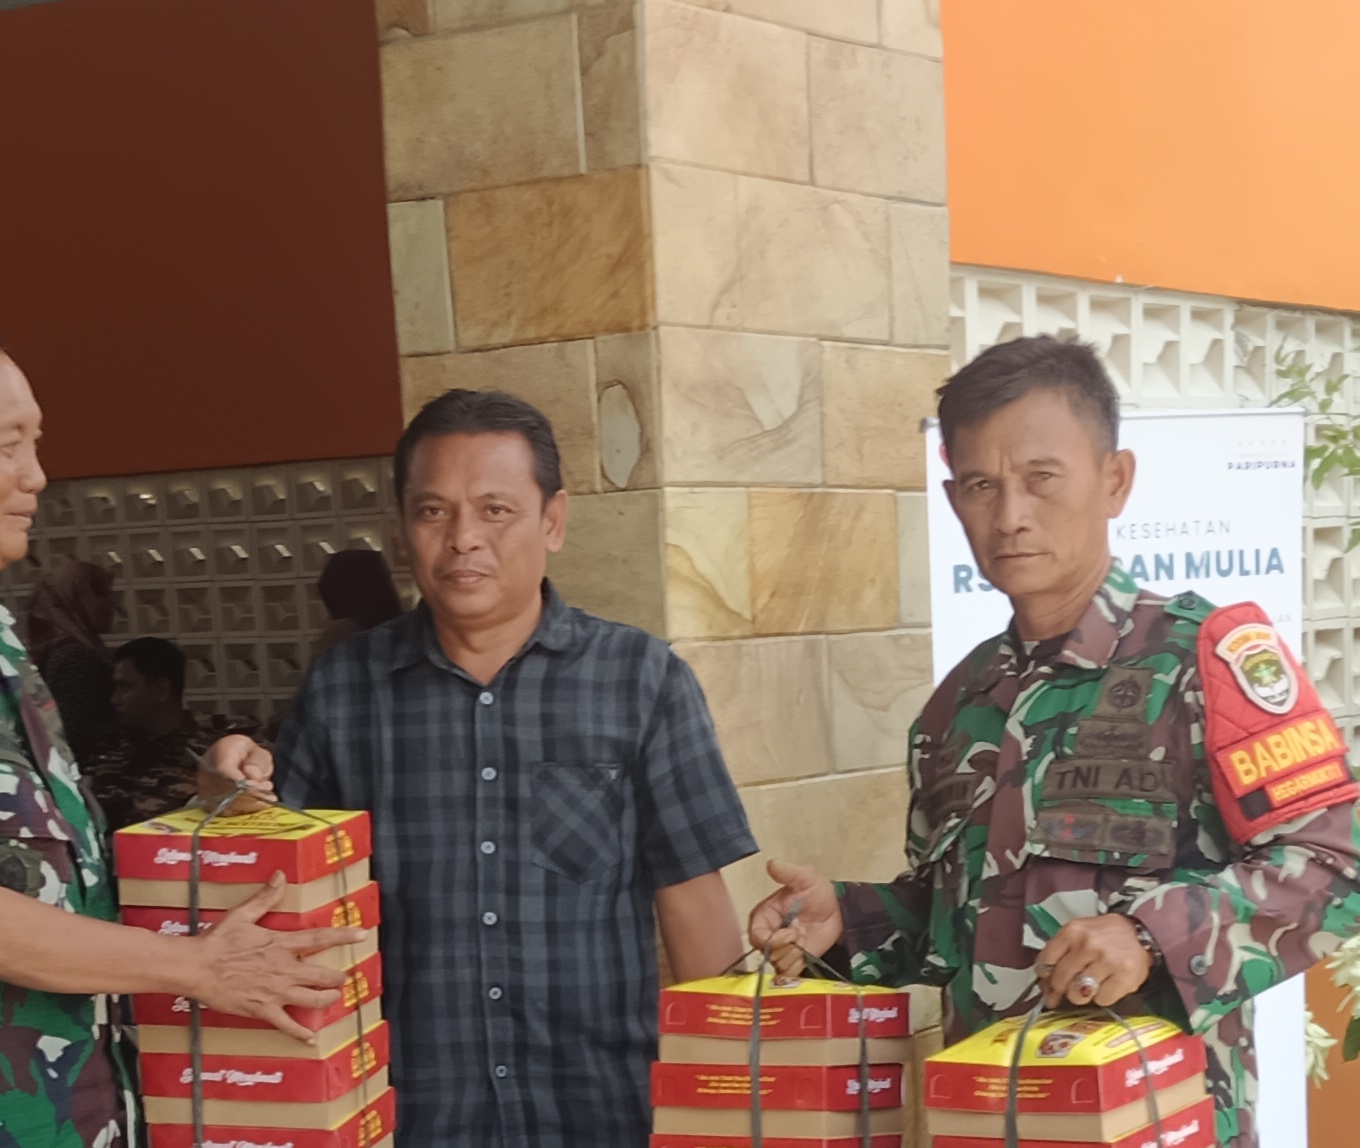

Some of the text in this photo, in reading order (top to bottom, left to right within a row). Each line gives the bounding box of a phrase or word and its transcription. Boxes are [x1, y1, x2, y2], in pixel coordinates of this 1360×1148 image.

[1115, 519, 1231, 540] KESEHATAN
[1184, 547, 1285, 580] MULIA
[1229, 718, 1341, 785] BABINSA
[1055, 765, 1159, 792] TNI AD
